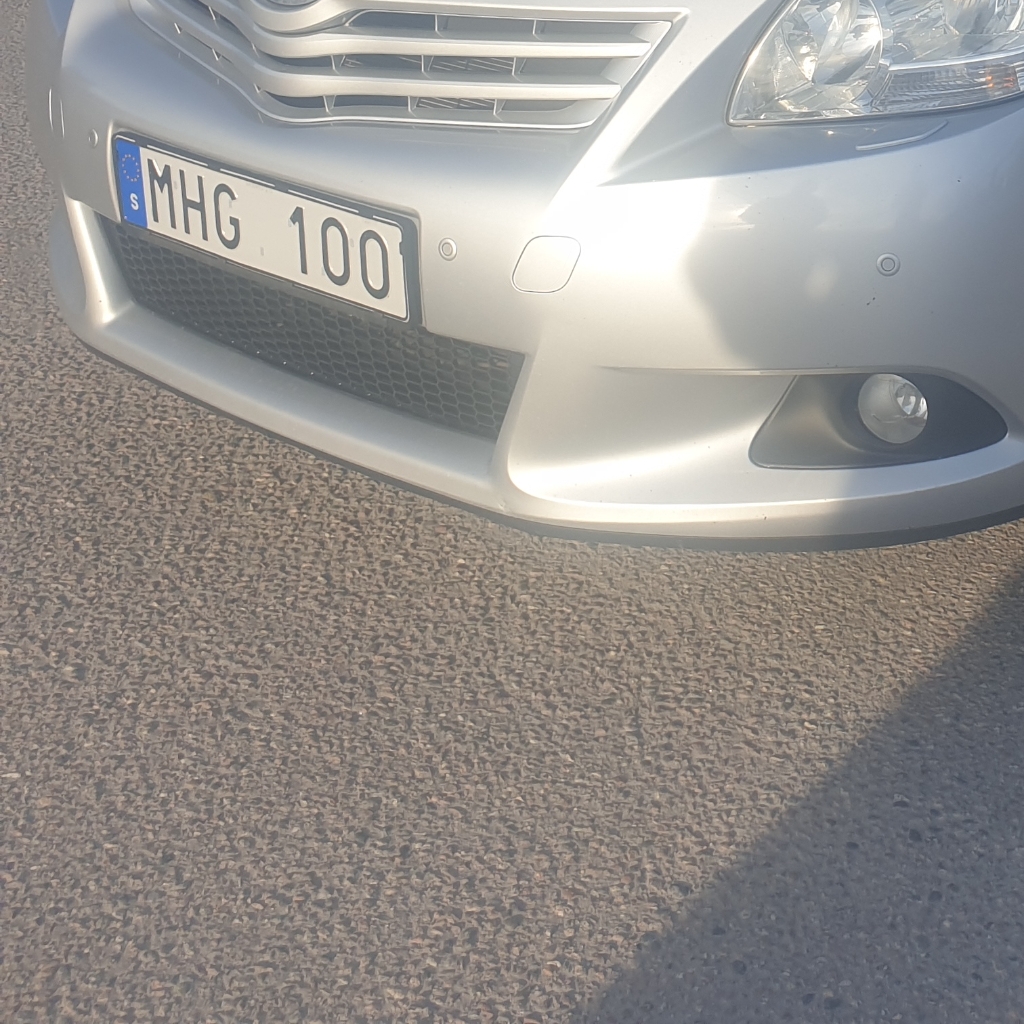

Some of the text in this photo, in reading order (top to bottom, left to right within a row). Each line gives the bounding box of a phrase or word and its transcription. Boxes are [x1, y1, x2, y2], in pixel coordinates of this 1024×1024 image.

[129, 193, 140, 212] S
[146, 158, 390, 300] MHG 100
